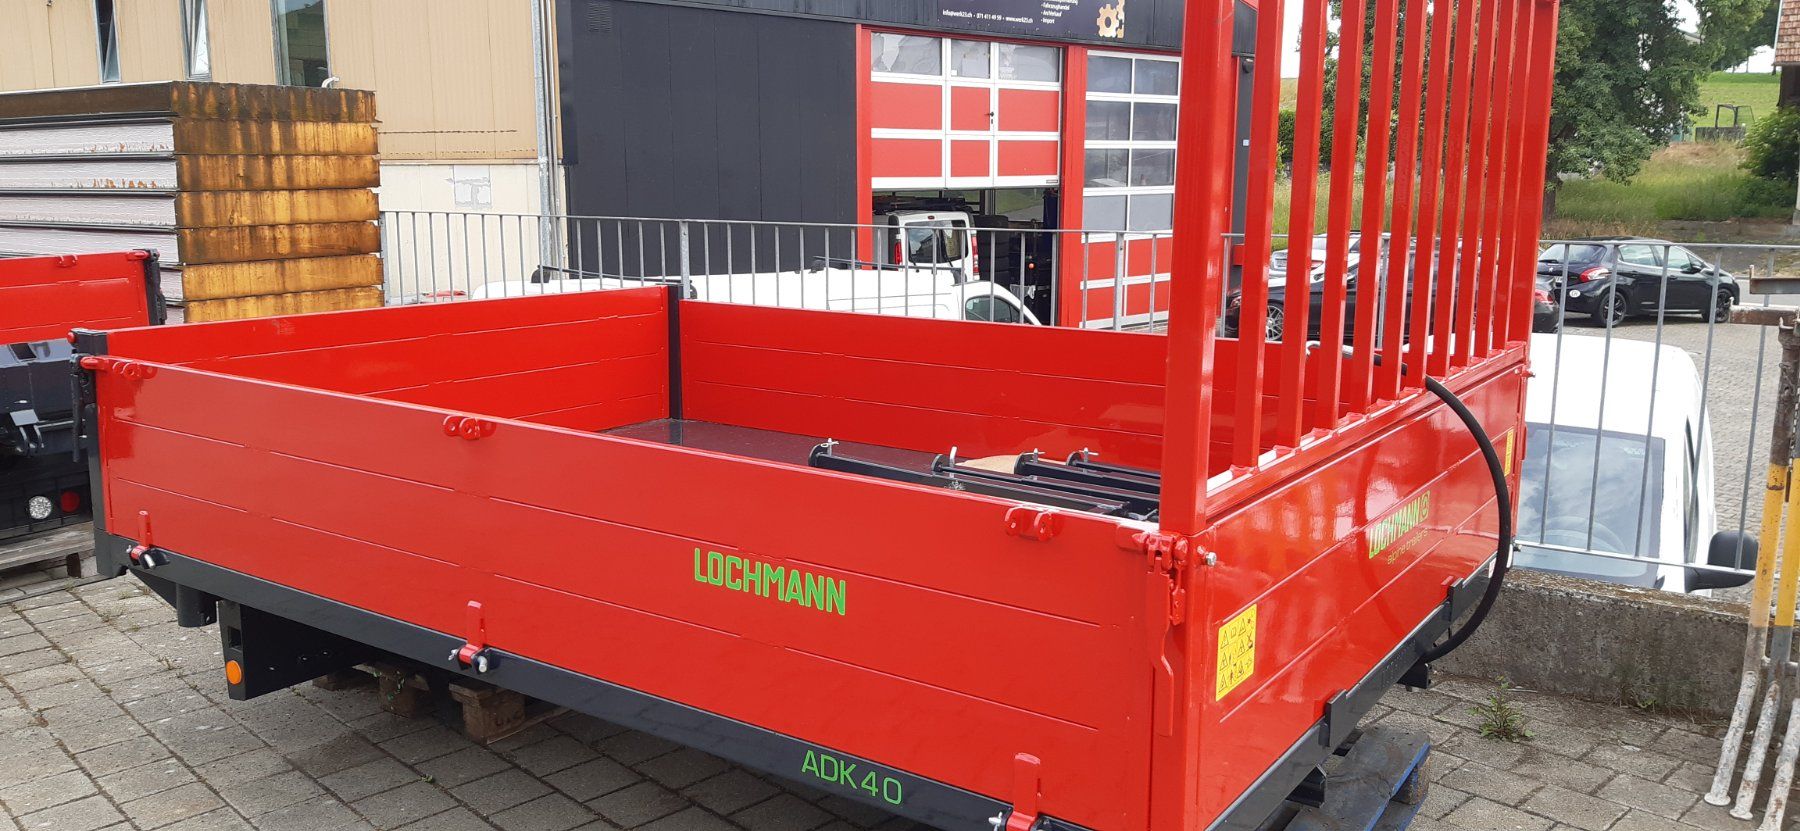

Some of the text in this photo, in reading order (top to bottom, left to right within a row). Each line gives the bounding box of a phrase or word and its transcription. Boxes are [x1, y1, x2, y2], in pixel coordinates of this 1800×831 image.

[1369, 497, 1421, 559] LOCHMANN
[1387, 528, 1428, 565] alpine trailers
[694, 547, 846, 616] LOCHMANN
